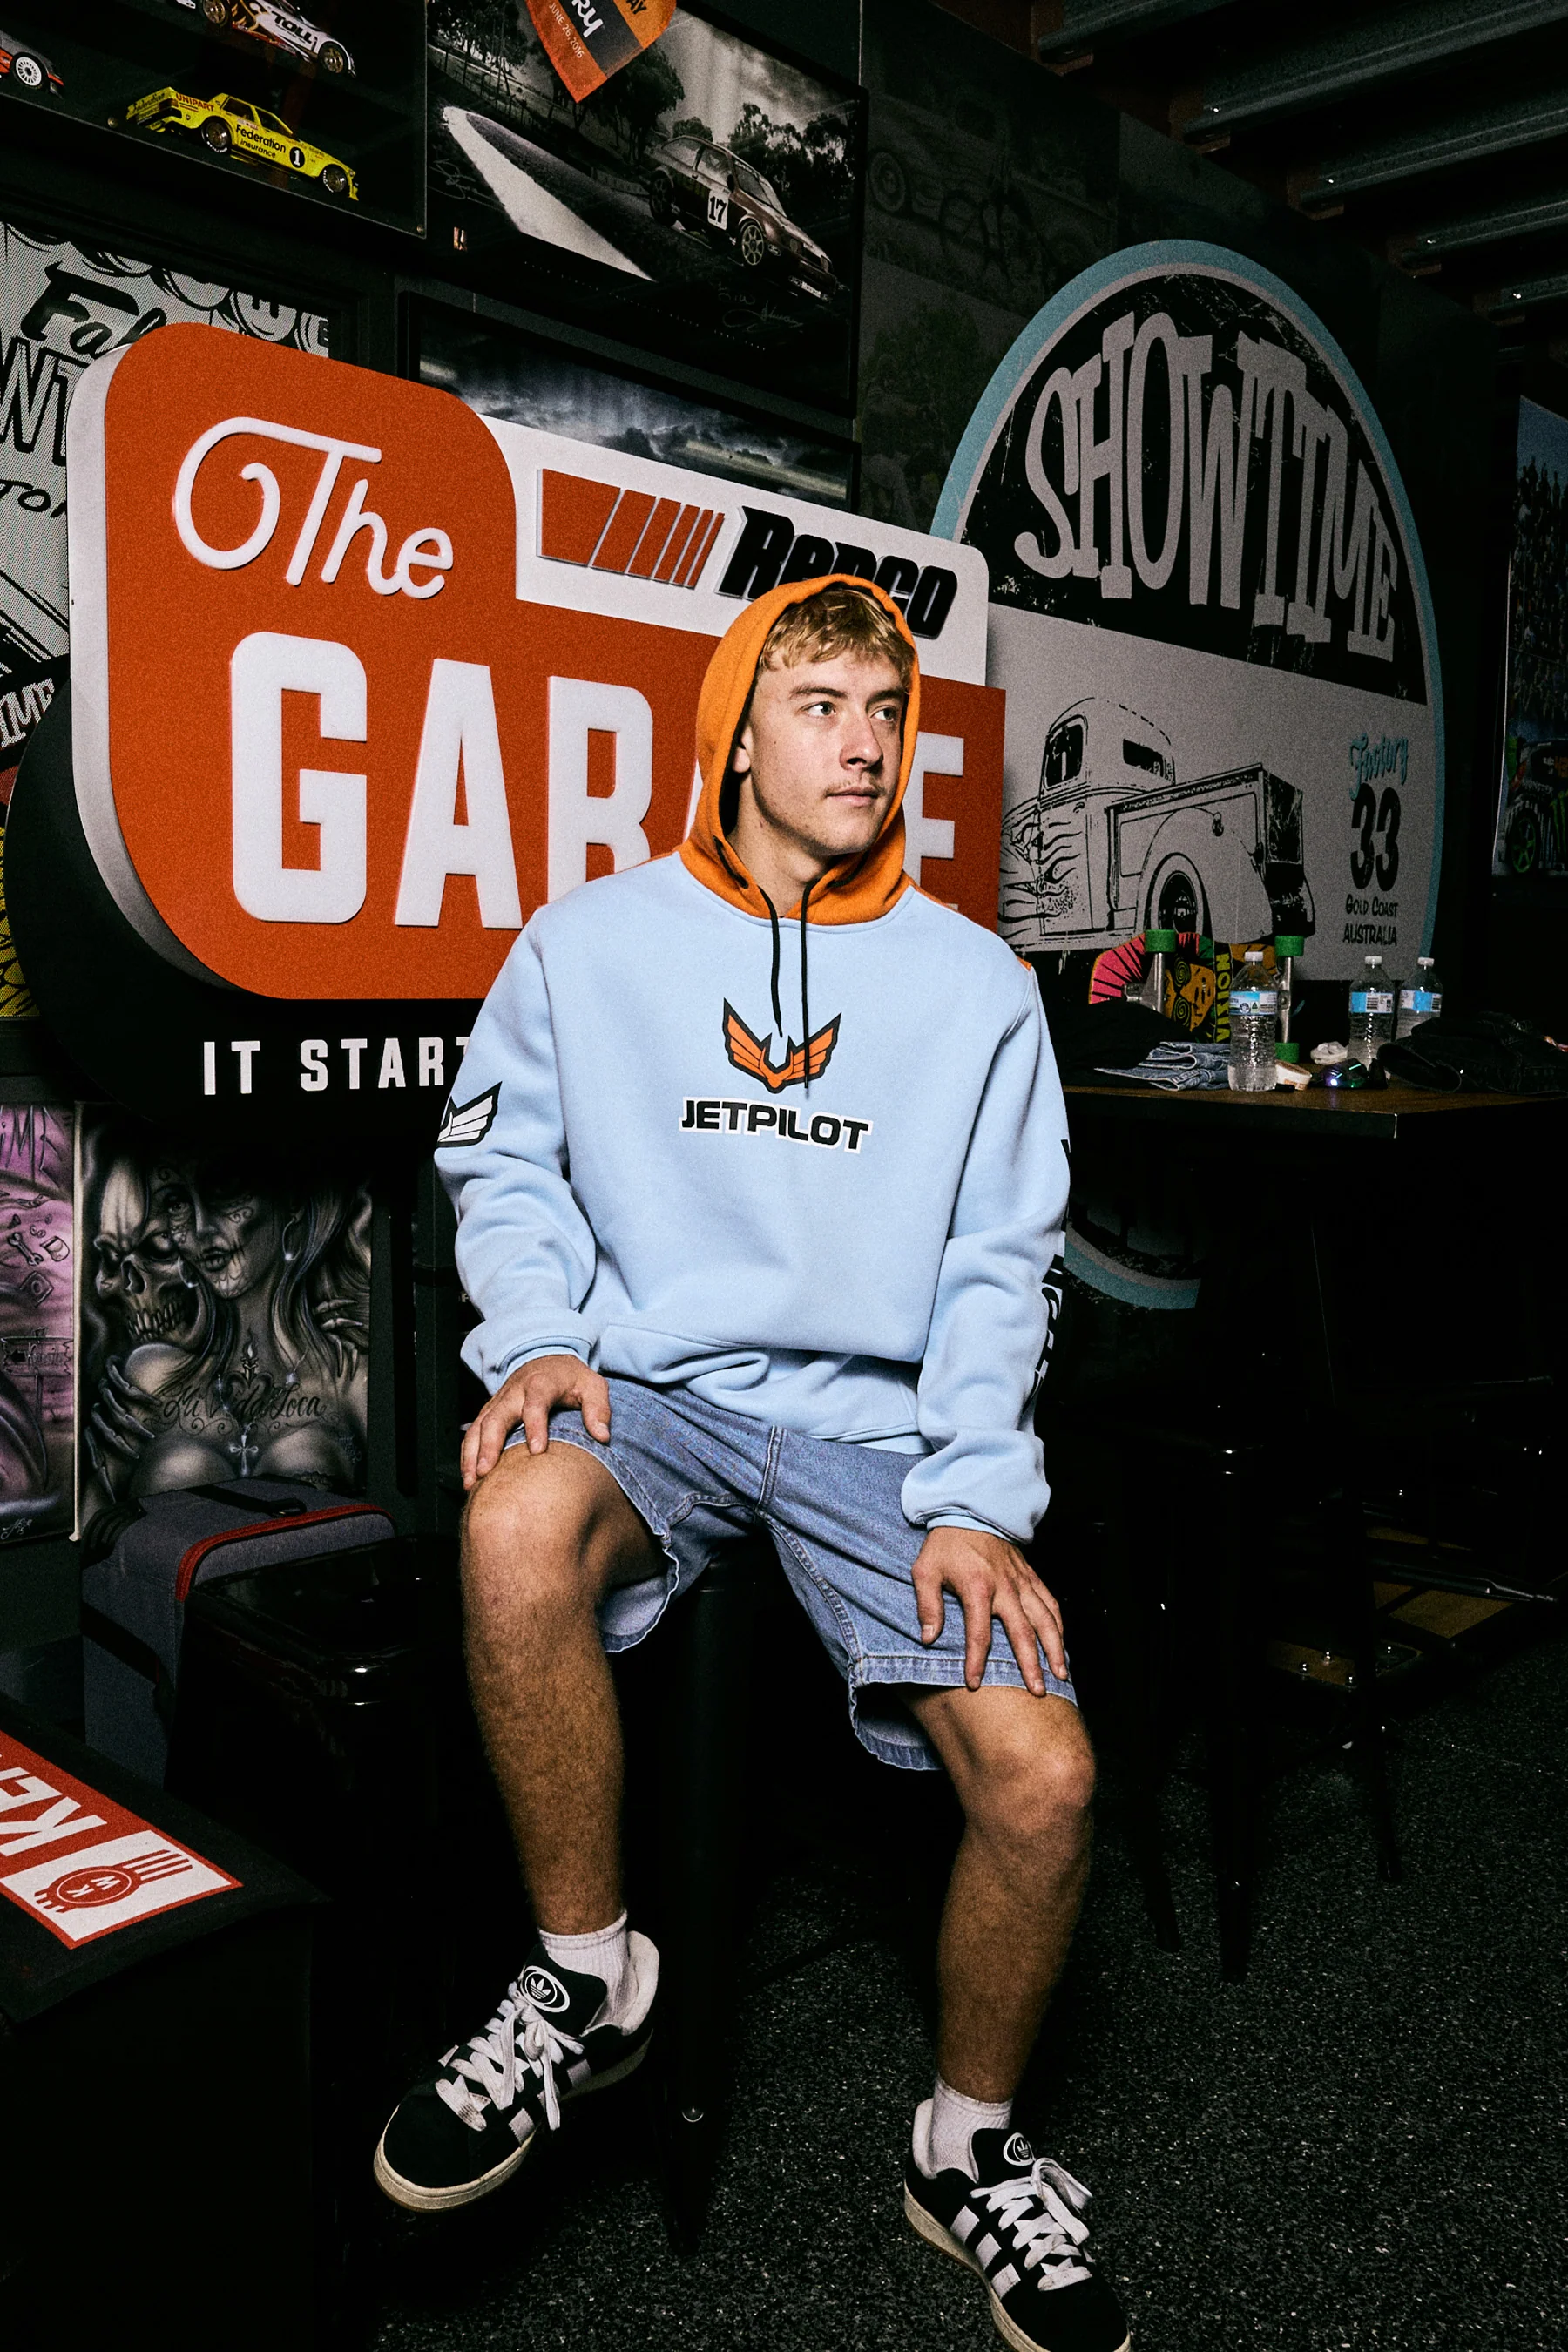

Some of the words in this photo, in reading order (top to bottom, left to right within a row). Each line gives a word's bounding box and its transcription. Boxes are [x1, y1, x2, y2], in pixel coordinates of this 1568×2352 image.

[271, 10, 313, 44] TOLL
[549, 3, 565, 25] JUNE
[570, 37, 585, 58] 2016
[175, 93, 214, 112] UNIPART
[236, 124, 287, 153] Federation
[293, 149, 301, 166] 1
[708, 195, 727, 224] 17
[173, 416, 454, 599] The
[1014, 311, 1398, 663] SHOWTIME
[231, 631, 965, 929] GARE
[1350, 782, 1401, 892] 33
[1342, 923, 1398, 947] AUSTRALIA
[1215, 952, 1231, 1043] VISION
[204, 1041, 260, 1095] IT
[680, 1098, 871, 1152] JETPILOT
